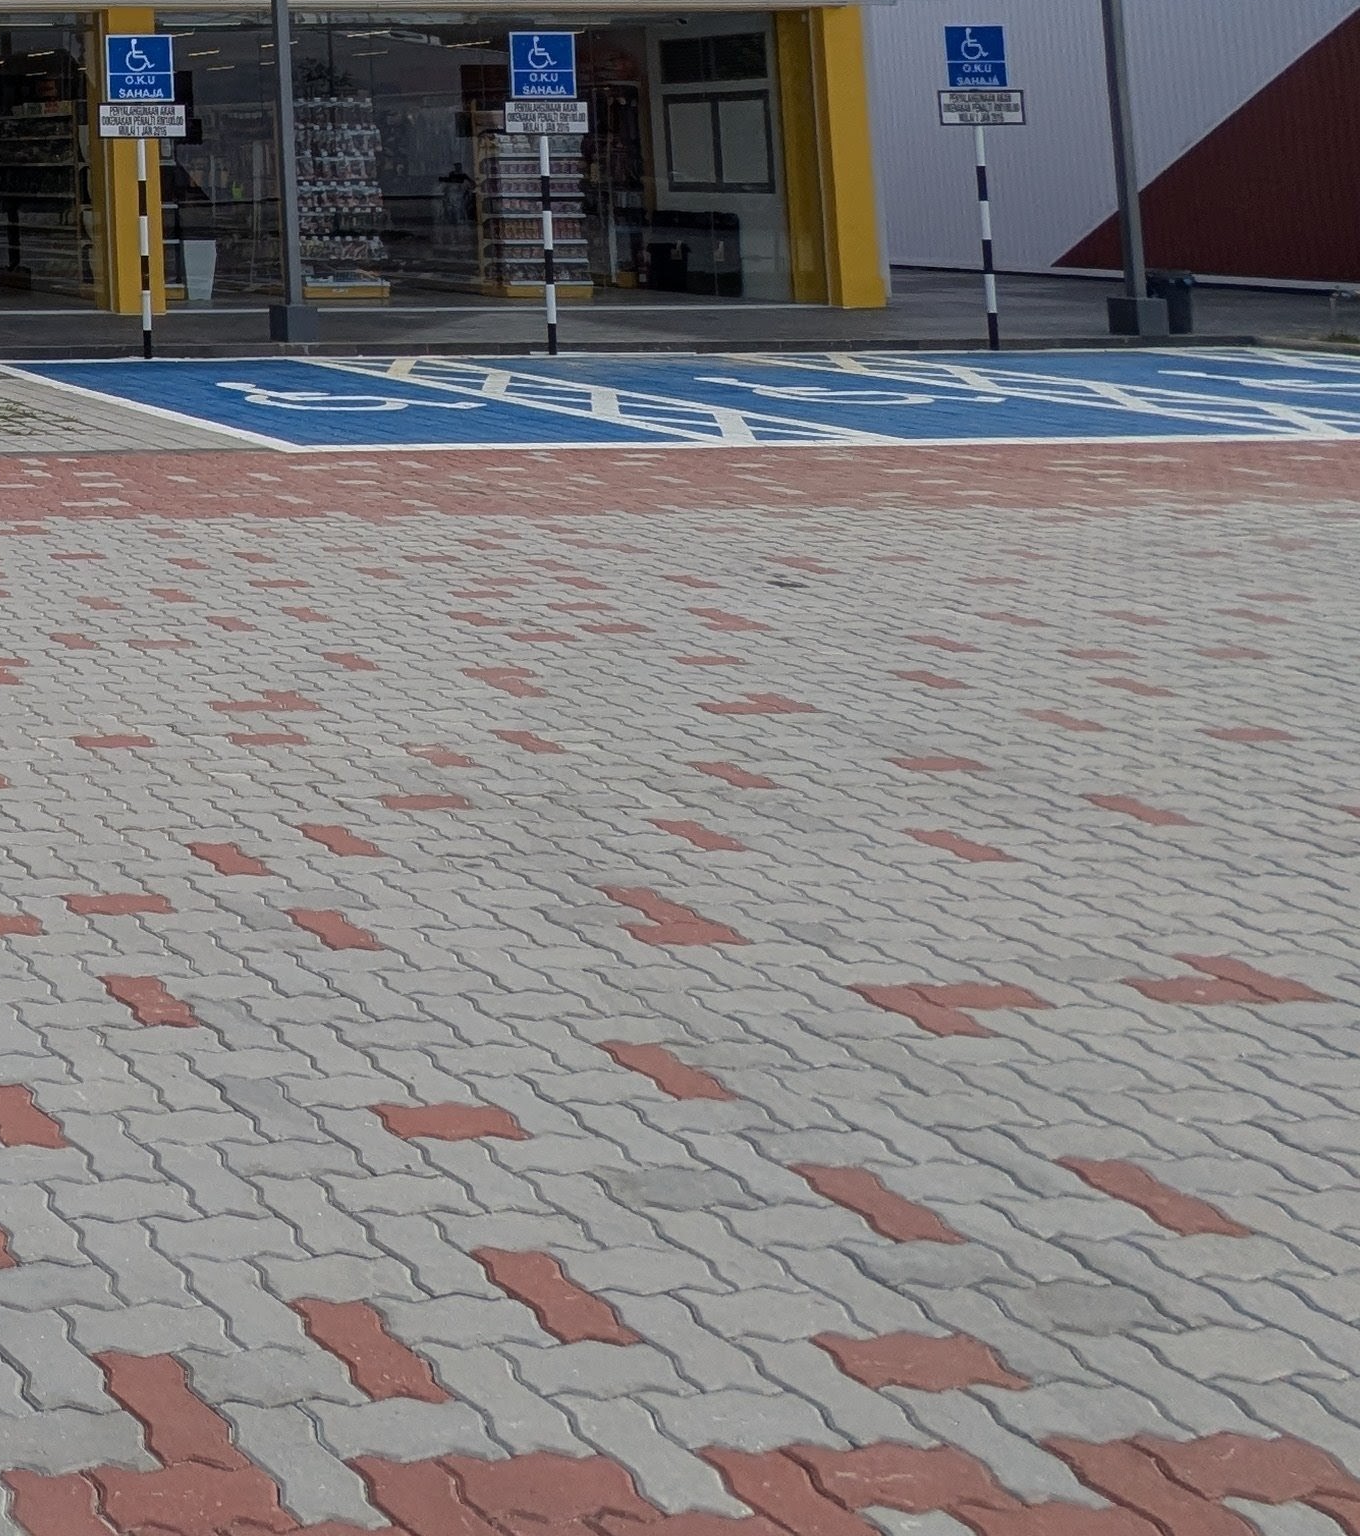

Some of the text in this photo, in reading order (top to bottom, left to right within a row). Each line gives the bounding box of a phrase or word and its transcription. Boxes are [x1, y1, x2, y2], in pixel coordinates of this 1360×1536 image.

[956, 75, 1000, 86] SAHAJA
[118, 88, 164, 98] SAHAJA
[522, 85, 567, 95] SAHAJA
